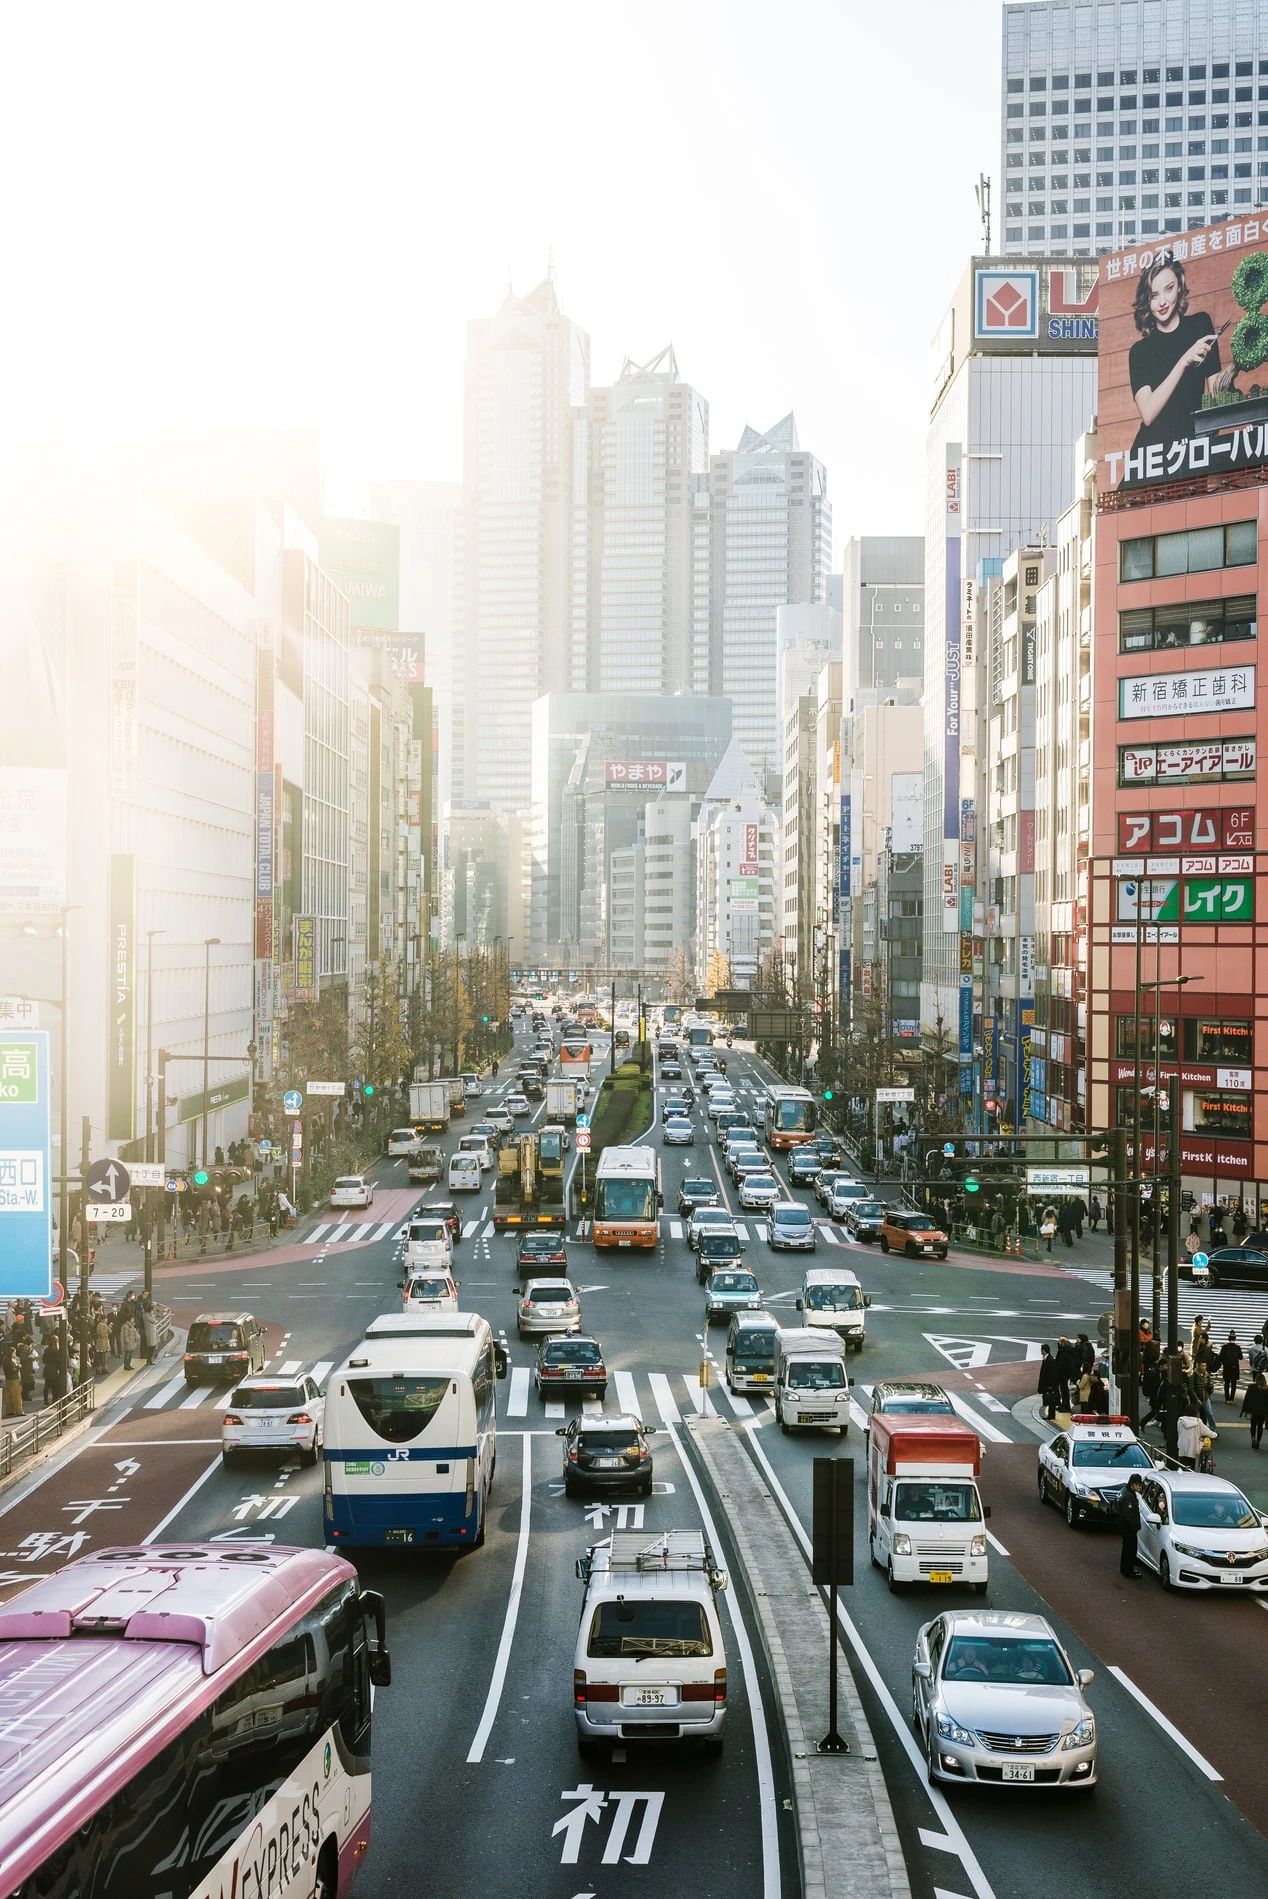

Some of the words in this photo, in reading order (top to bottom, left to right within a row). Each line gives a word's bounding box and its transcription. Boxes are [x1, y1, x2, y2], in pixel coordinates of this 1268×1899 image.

[946, 469, 957, 499] LABI
[1131, 672, 1248, 703] 新宿矯正歯科
[946, 689, 959, 715] Your
[946, 715, 959, 736] For
[609, 764, 663, 779] やまや
[1156, 752, 1254, 775] エーアイアール
[259, 793, 271, 830] JAPAN
[961, 799, 975, 810] 6F
[1125, 812, 1217, 849] アコム
[1230, 812, 1249, 828] 6F
[259, 831, 271, 860] TOTAL
[1238, 834, 1252, 846] 入口
[1185, 860, 1213, 872] アコム
[1222, 858, 1250, 871] アコム
[259, 862, 271, 890] CLUB
[944, 864, 954, 893] LABI
[1140, 885, 1166, 895] 生銀行
[1184, 885, 1245, 913] レイク
[961, 938, 972, 966] トレカ
[1202, 1025, 1221, 1036] First
[2, 1048, 31, 1079] 高
[1181, 1072, 1212, 1082] Kitchen
[1202, 1101, 1221, 1111] First
[1182, 1151, 1204, 1162] First
[1205, 1153, 1248, 1165] Kitchen
[0, 1158, 37, 1187] 西口
[387, 1448, 410, 1461] JR
[402, 1533, 413, 1542] 16
[641, 1694, 665, 1704] 89-97
[1009, 1770, 1032, 1779] 34-61
[551, 1784, 665, 1864] 初
[241, 1781, 321, 1899] EXPRESS
